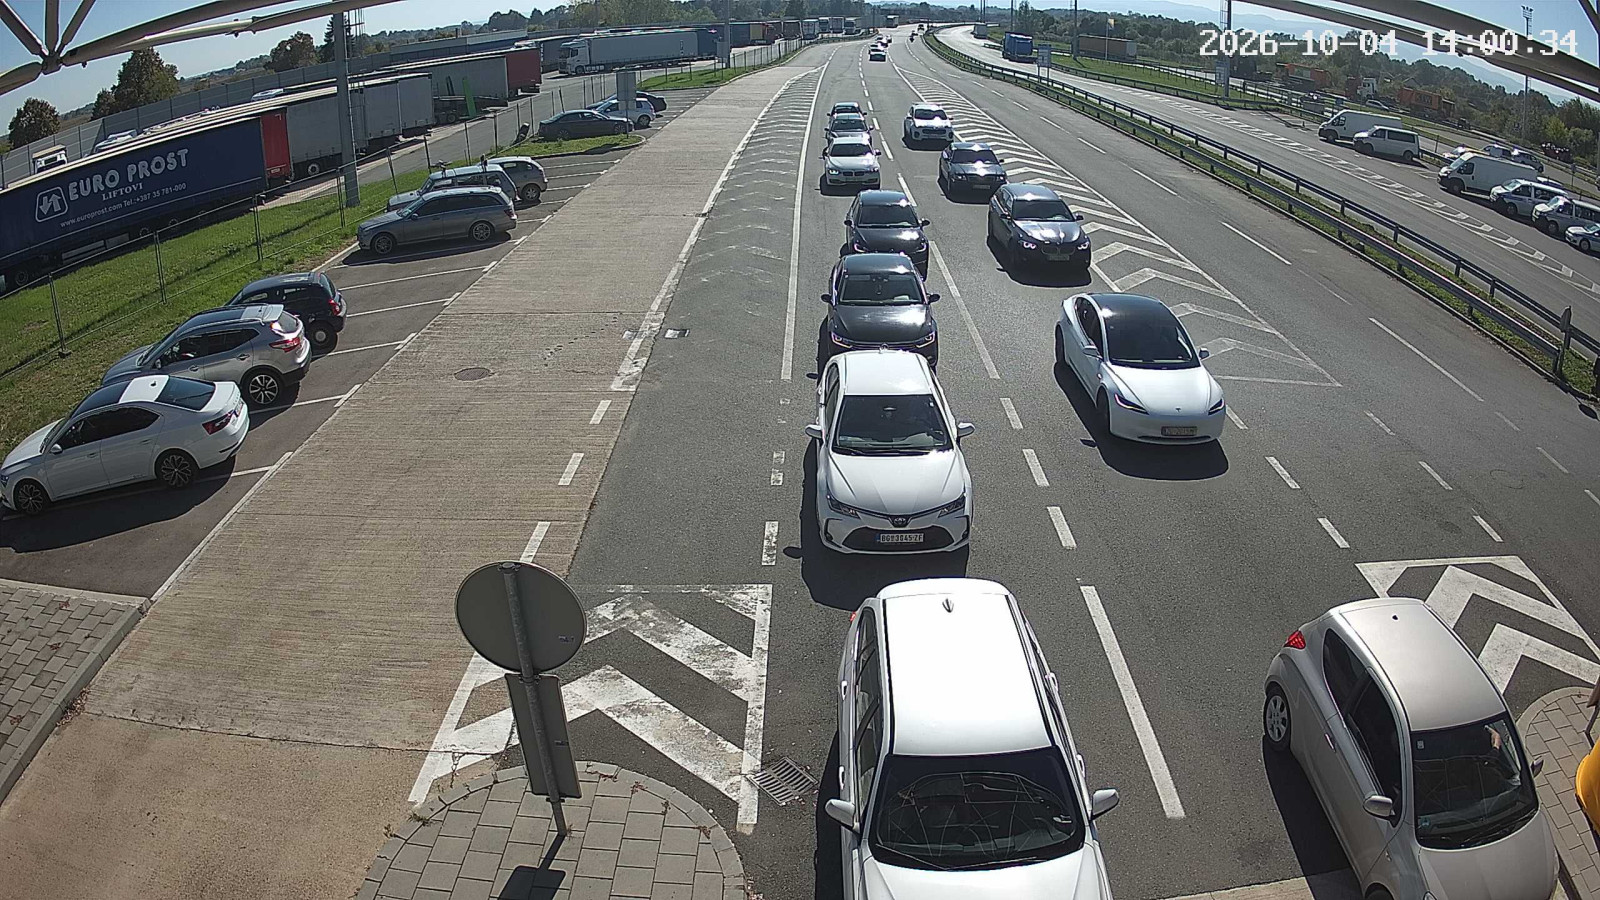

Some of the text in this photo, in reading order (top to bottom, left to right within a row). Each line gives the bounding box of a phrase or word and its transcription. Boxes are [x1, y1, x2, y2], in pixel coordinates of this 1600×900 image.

[68, 148, 189, 201] EURO PROST
[102, 182, 144, 201] LIFTOVI
[60, 203, 122, 228] www.europrost.com
